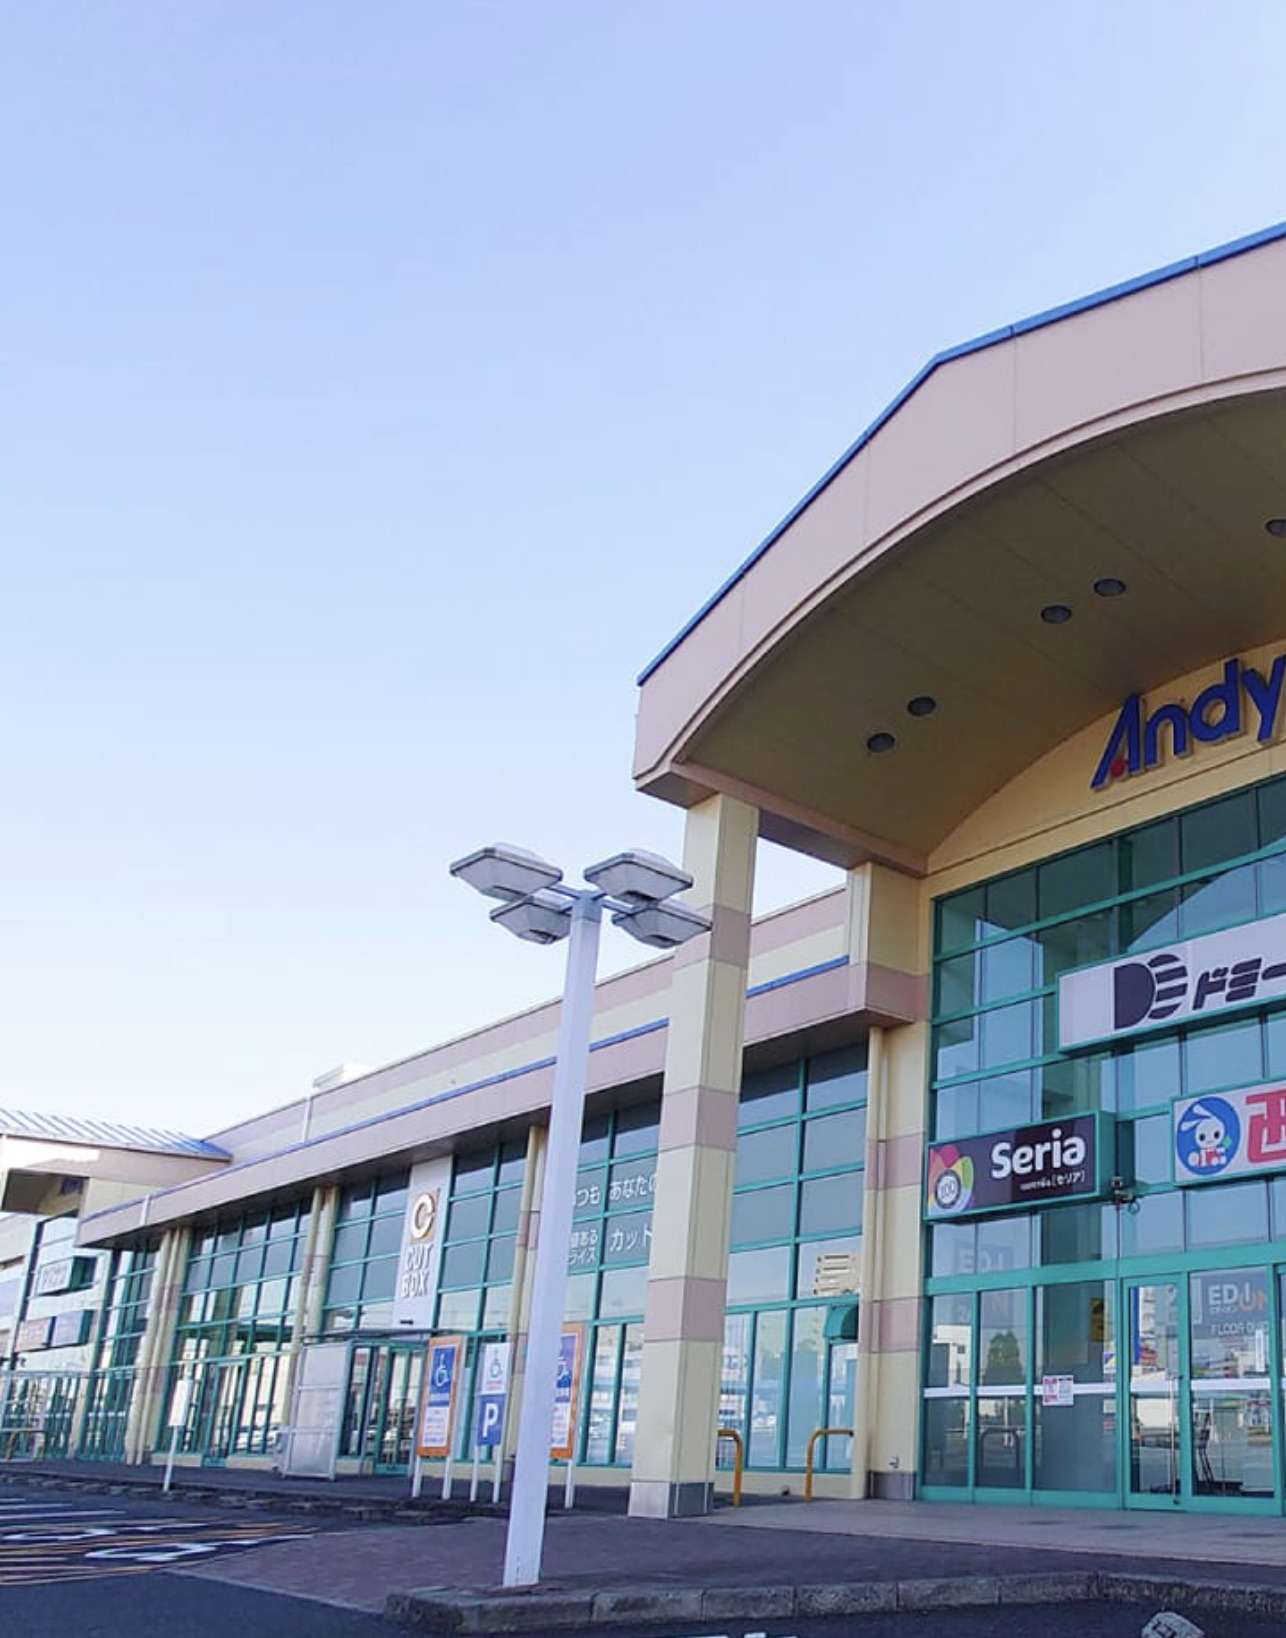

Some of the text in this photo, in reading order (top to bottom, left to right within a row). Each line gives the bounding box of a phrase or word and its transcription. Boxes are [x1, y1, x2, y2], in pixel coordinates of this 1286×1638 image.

[990, 1128, 1086, 1179] Seria
[573, 1186, 601, 1207] つも
[406, 1243, 434, 1272] CUT
[401, 1270, 430, 1299] BOX
[482, 1402, 500, 1438] P
